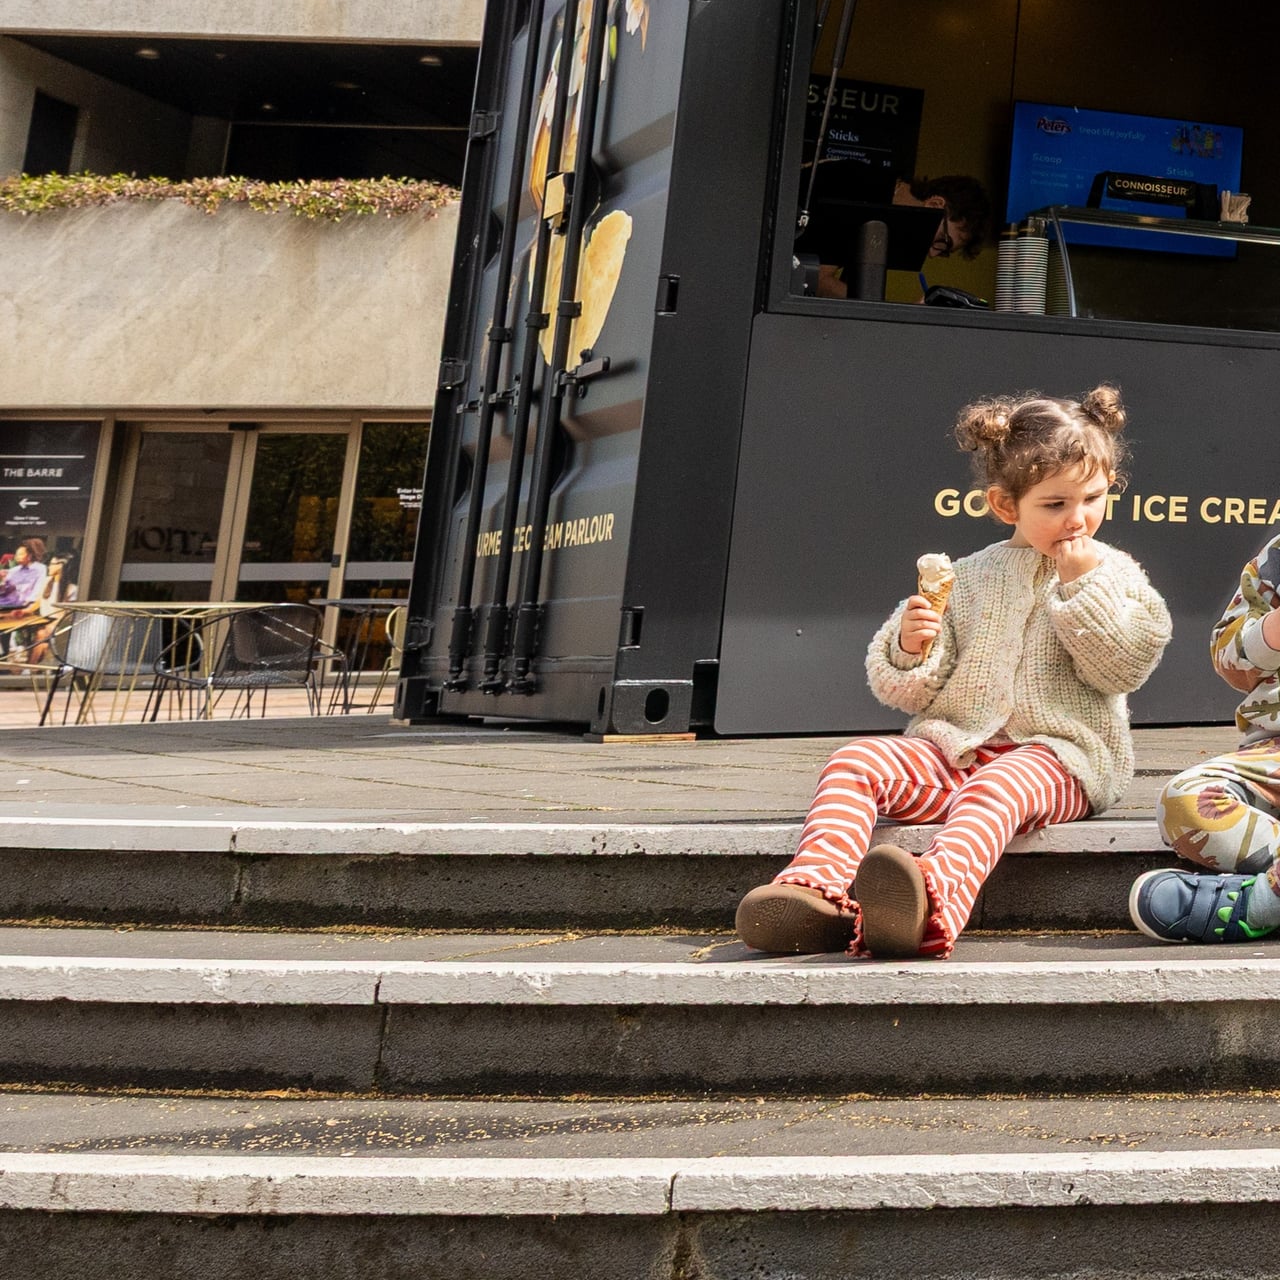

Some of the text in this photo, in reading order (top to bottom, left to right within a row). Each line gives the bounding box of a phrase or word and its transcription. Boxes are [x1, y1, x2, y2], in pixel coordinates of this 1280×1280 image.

[807, 82, 901, 116] SSEUR
[829, 127, 860, 144] Sticks
[1114, 178, 1188, 197] CONNOISSEUR
[4, 467, 64, 478] THE BARRE
[1133, 495, 1188, 523] ICE
[563, 512, 615, 548] PARLOUR
